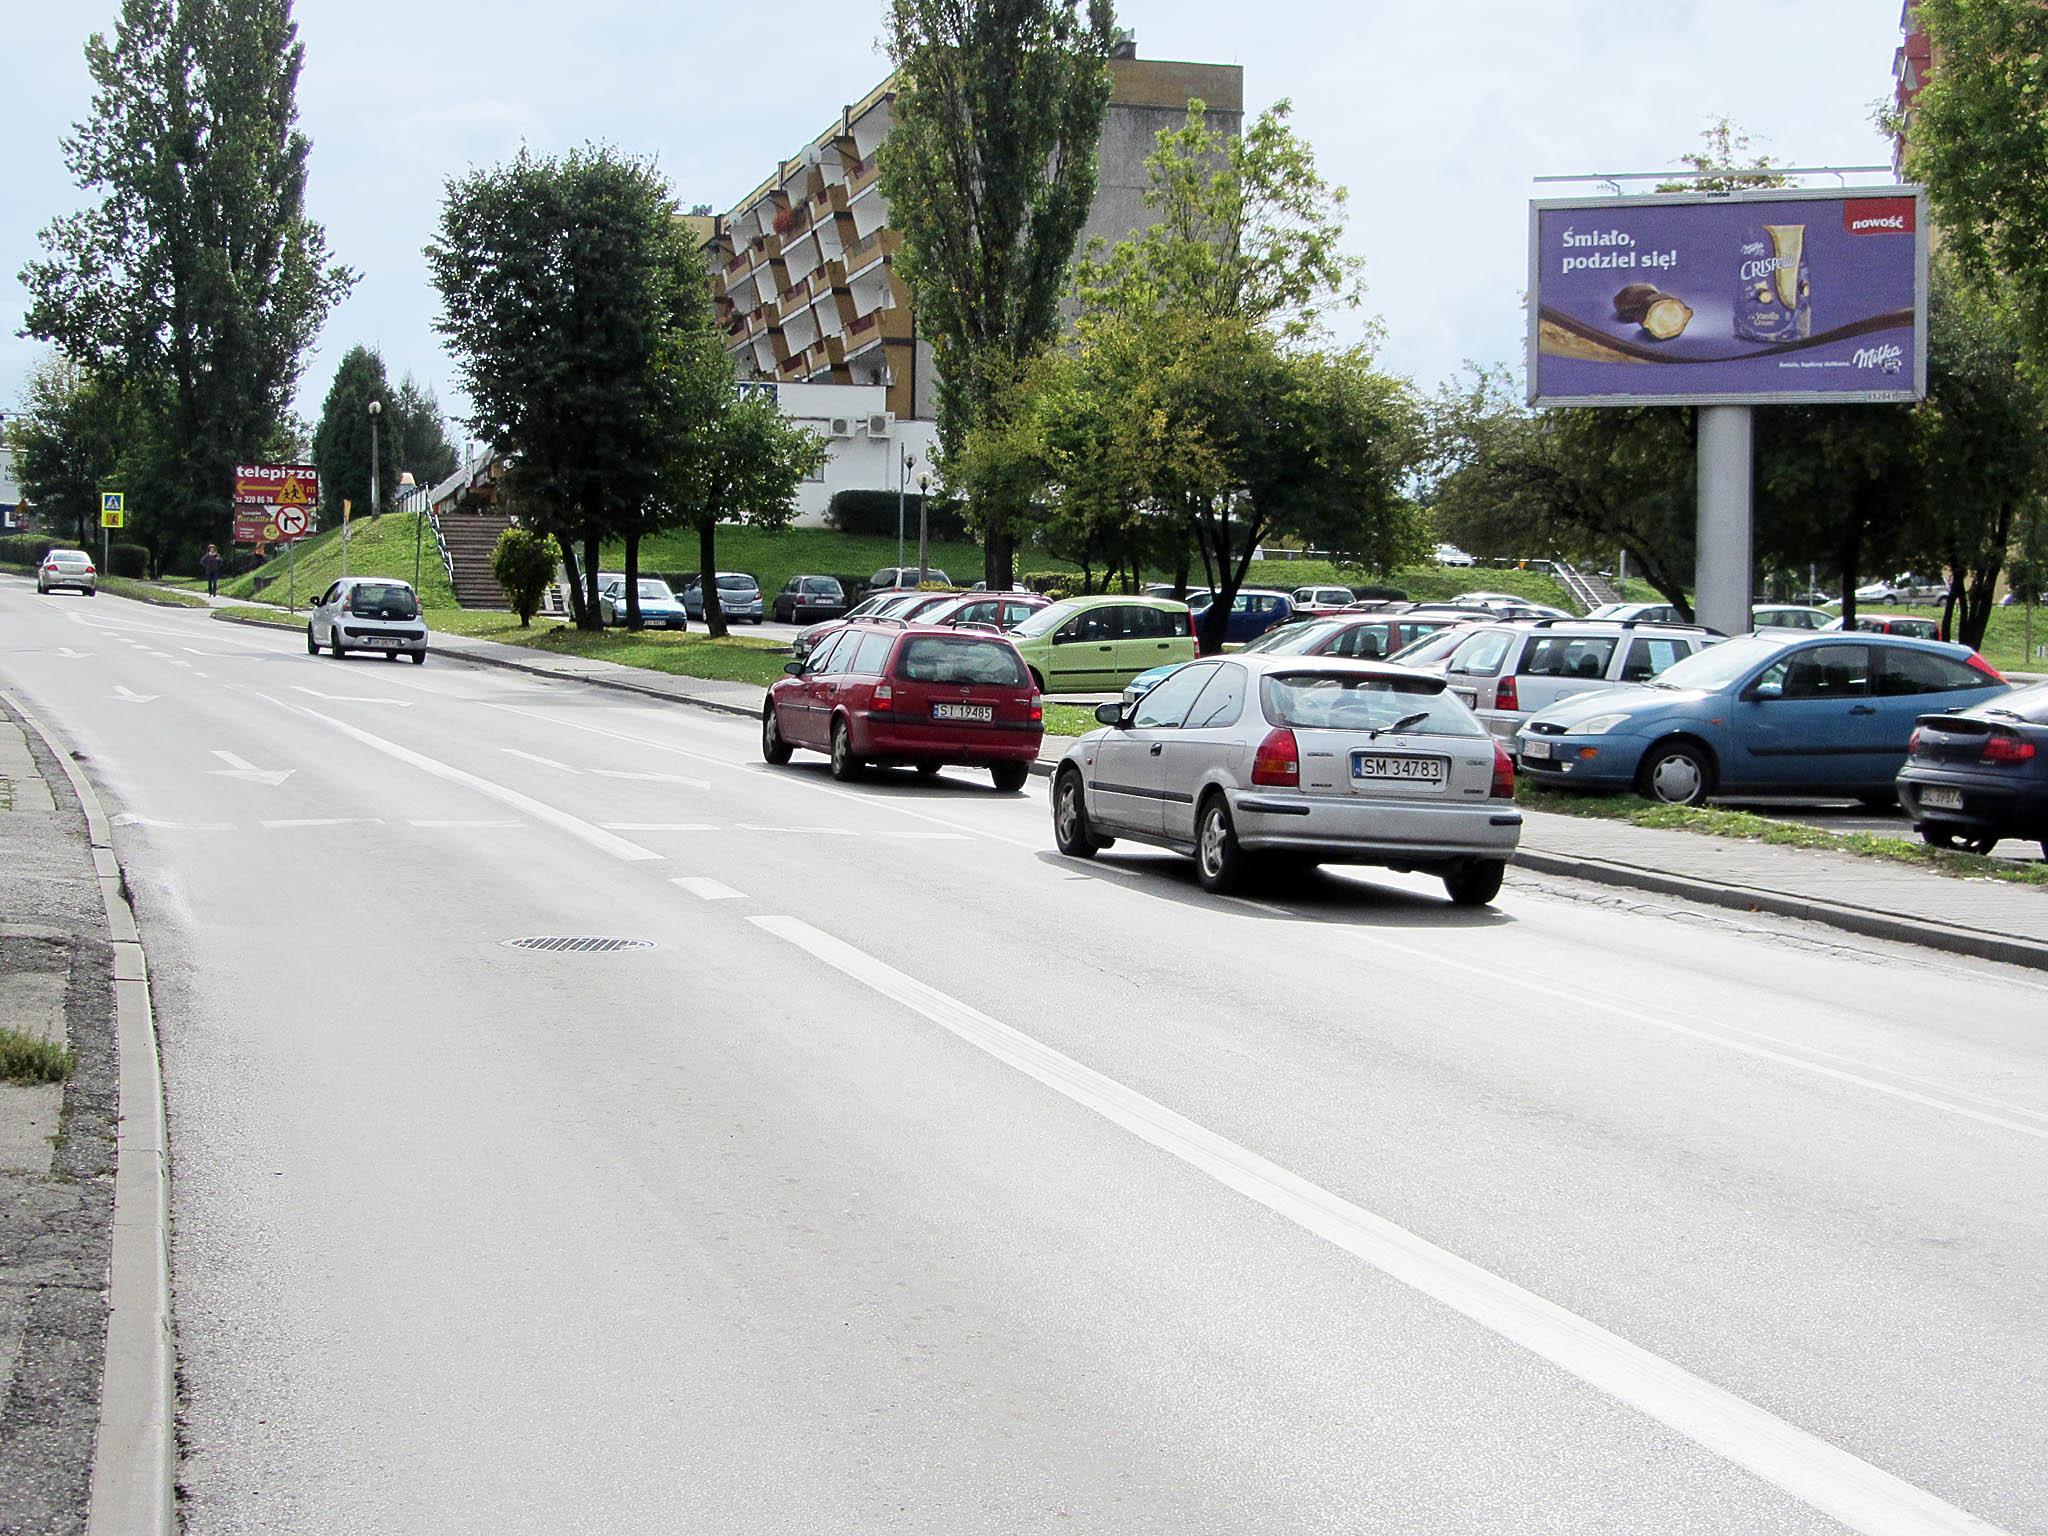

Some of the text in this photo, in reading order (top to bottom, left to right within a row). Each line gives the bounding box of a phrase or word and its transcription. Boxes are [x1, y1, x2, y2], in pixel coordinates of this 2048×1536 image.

[1852, 215, 1904, 230] nowość
[1562, 226, 1636, 248] Śmiało,
[1562, 250, 1677, 274] podziel się!
[1852, 343, 1903, 369] Milka
[236, 466, 317, 481] telepizza
[960, 706, 991, 719] 19485
[1364, 759, 1439, 777] SM 34783
